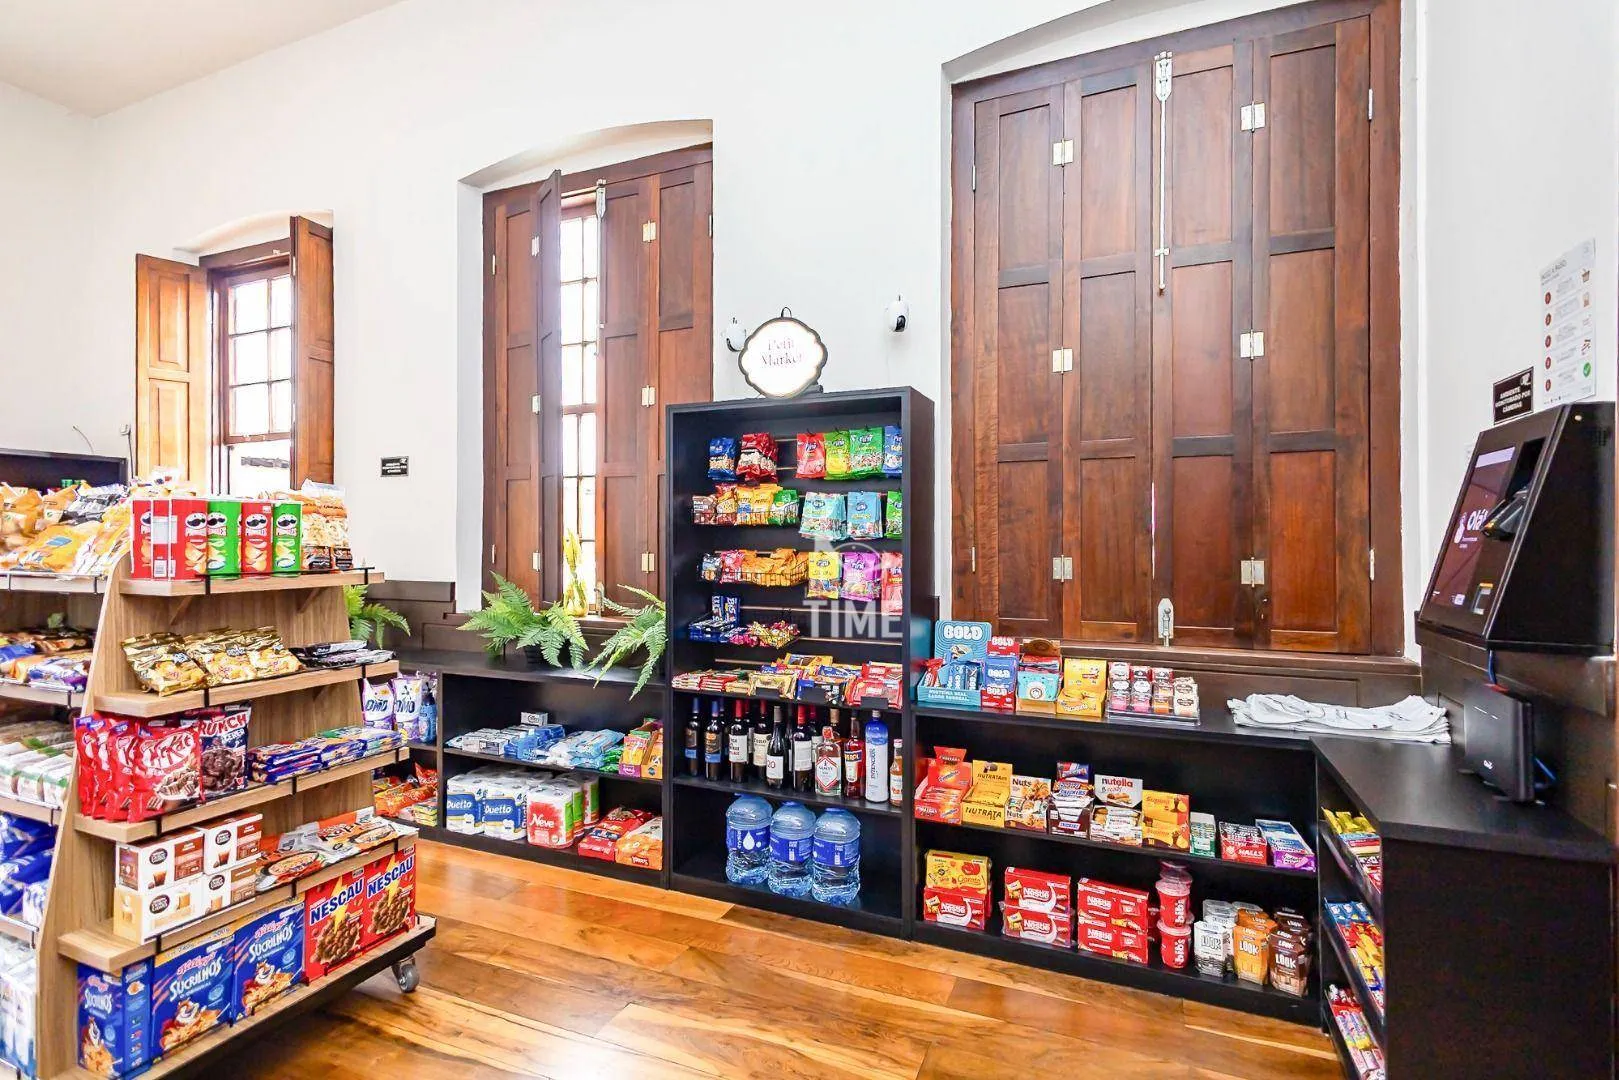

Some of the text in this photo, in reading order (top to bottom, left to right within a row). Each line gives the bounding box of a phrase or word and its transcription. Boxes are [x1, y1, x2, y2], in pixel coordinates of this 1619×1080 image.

[943, 625, 983, 641] BOLD
[991, 636, 1014, 647] BOLD
[198, 711, 247, 738] RUNCH
[1012, 778, 1032, 787] Nuts
[1101, 778, 1133, 788] nutella
[446, 800, 473, 810] Duetto
[485, 804, 512, 815] Duetto
[965, 806, 1002, 818] NUTRATA
[530, 814, 555, 829] Neve
[1238, 849, 1264, 858] HALLS
[366, 855, 414, 899] NESCAU
[310, 878, 364, 925] NESCAU
[249, 922, 294, 964] SUCRILHOS
[1201, 934, 1222, 950] LOOK
[1239, 940, 1259, 956] LOOK
[1275, 953, 1297, 969] LOOK
[169, 954, 223, 1003] SUCRILHOS
